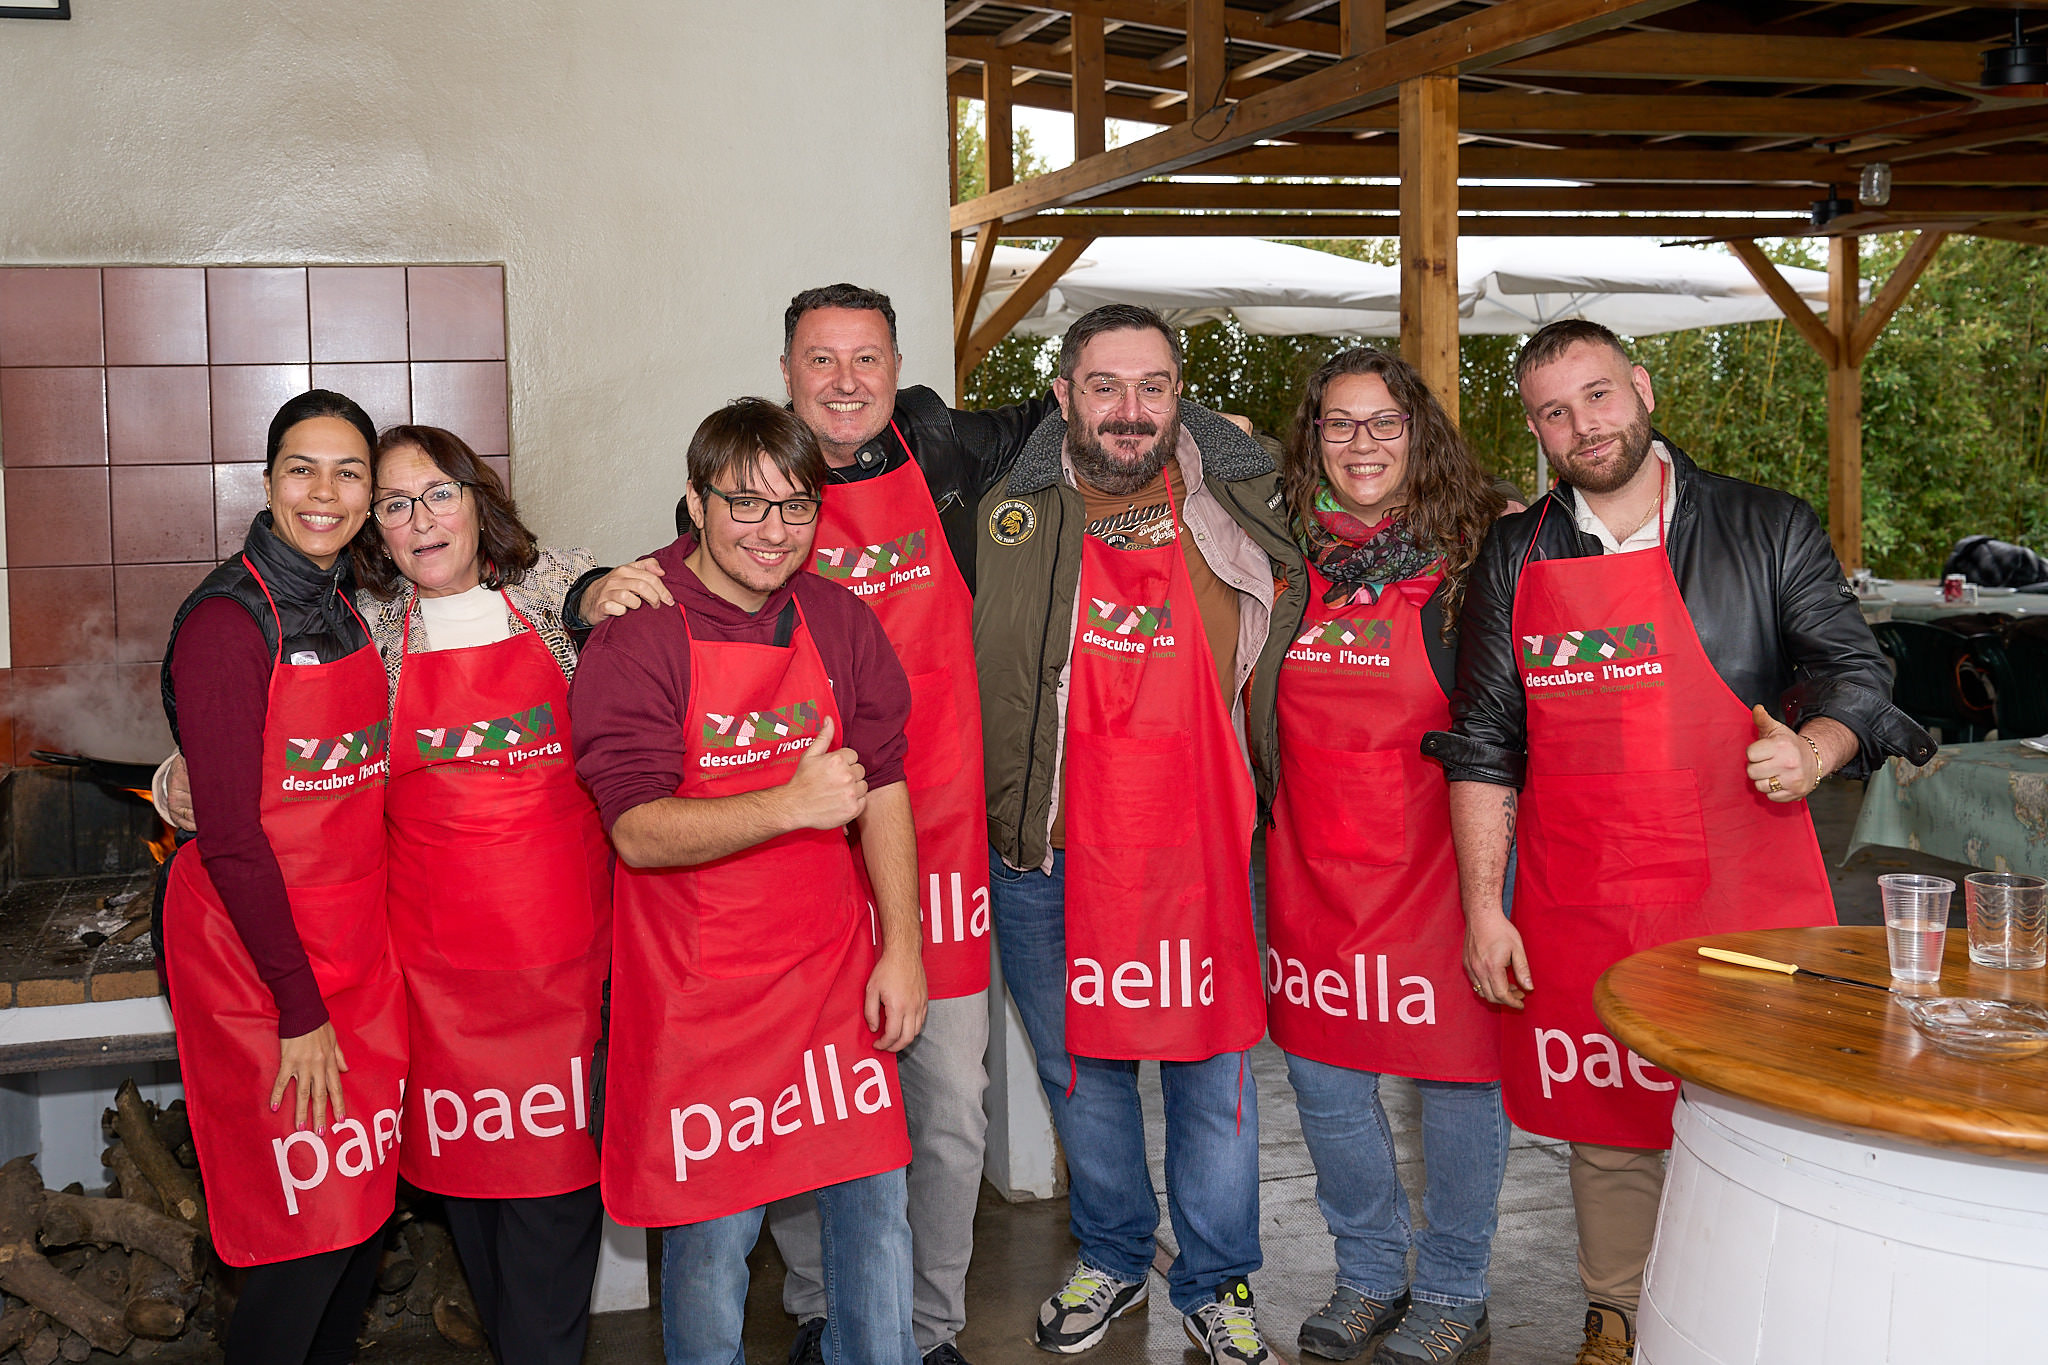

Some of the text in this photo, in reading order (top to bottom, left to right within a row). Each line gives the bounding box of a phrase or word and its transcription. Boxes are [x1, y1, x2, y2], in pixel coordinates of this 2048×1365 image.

[993, 503, 1012, 519] SPECIAL
[1085, 503, 1172, 537] emium
[889, 564, 931, 587] l'horta
[1082, 630, 1146, 653] descubre
[1284, 647, 1390, 667] scubre l'horta
[1525, 661, 1663, 688] descubre l'horta
[1600, 684, 1634, 695] discover
[1636, 680, 1665, 691] l'horta
[507, 742, 562, 766] l'horta
[699, 749, 772, 768] descubre
[282, 773, 355, 792] descubre
[358, 759, 386, 782] l'hort
[920, 872, 990, 944] lla
[1066, 939, 1214, 1008] aella
[1267, 944, 1436, 1025] paella
[1534, 1027, 1675, 1099] pae
[423, 1056, 586, 1157] pael
[670, 1043, 892, 1182] paella
[272, 1079, 405, 1216] pae
